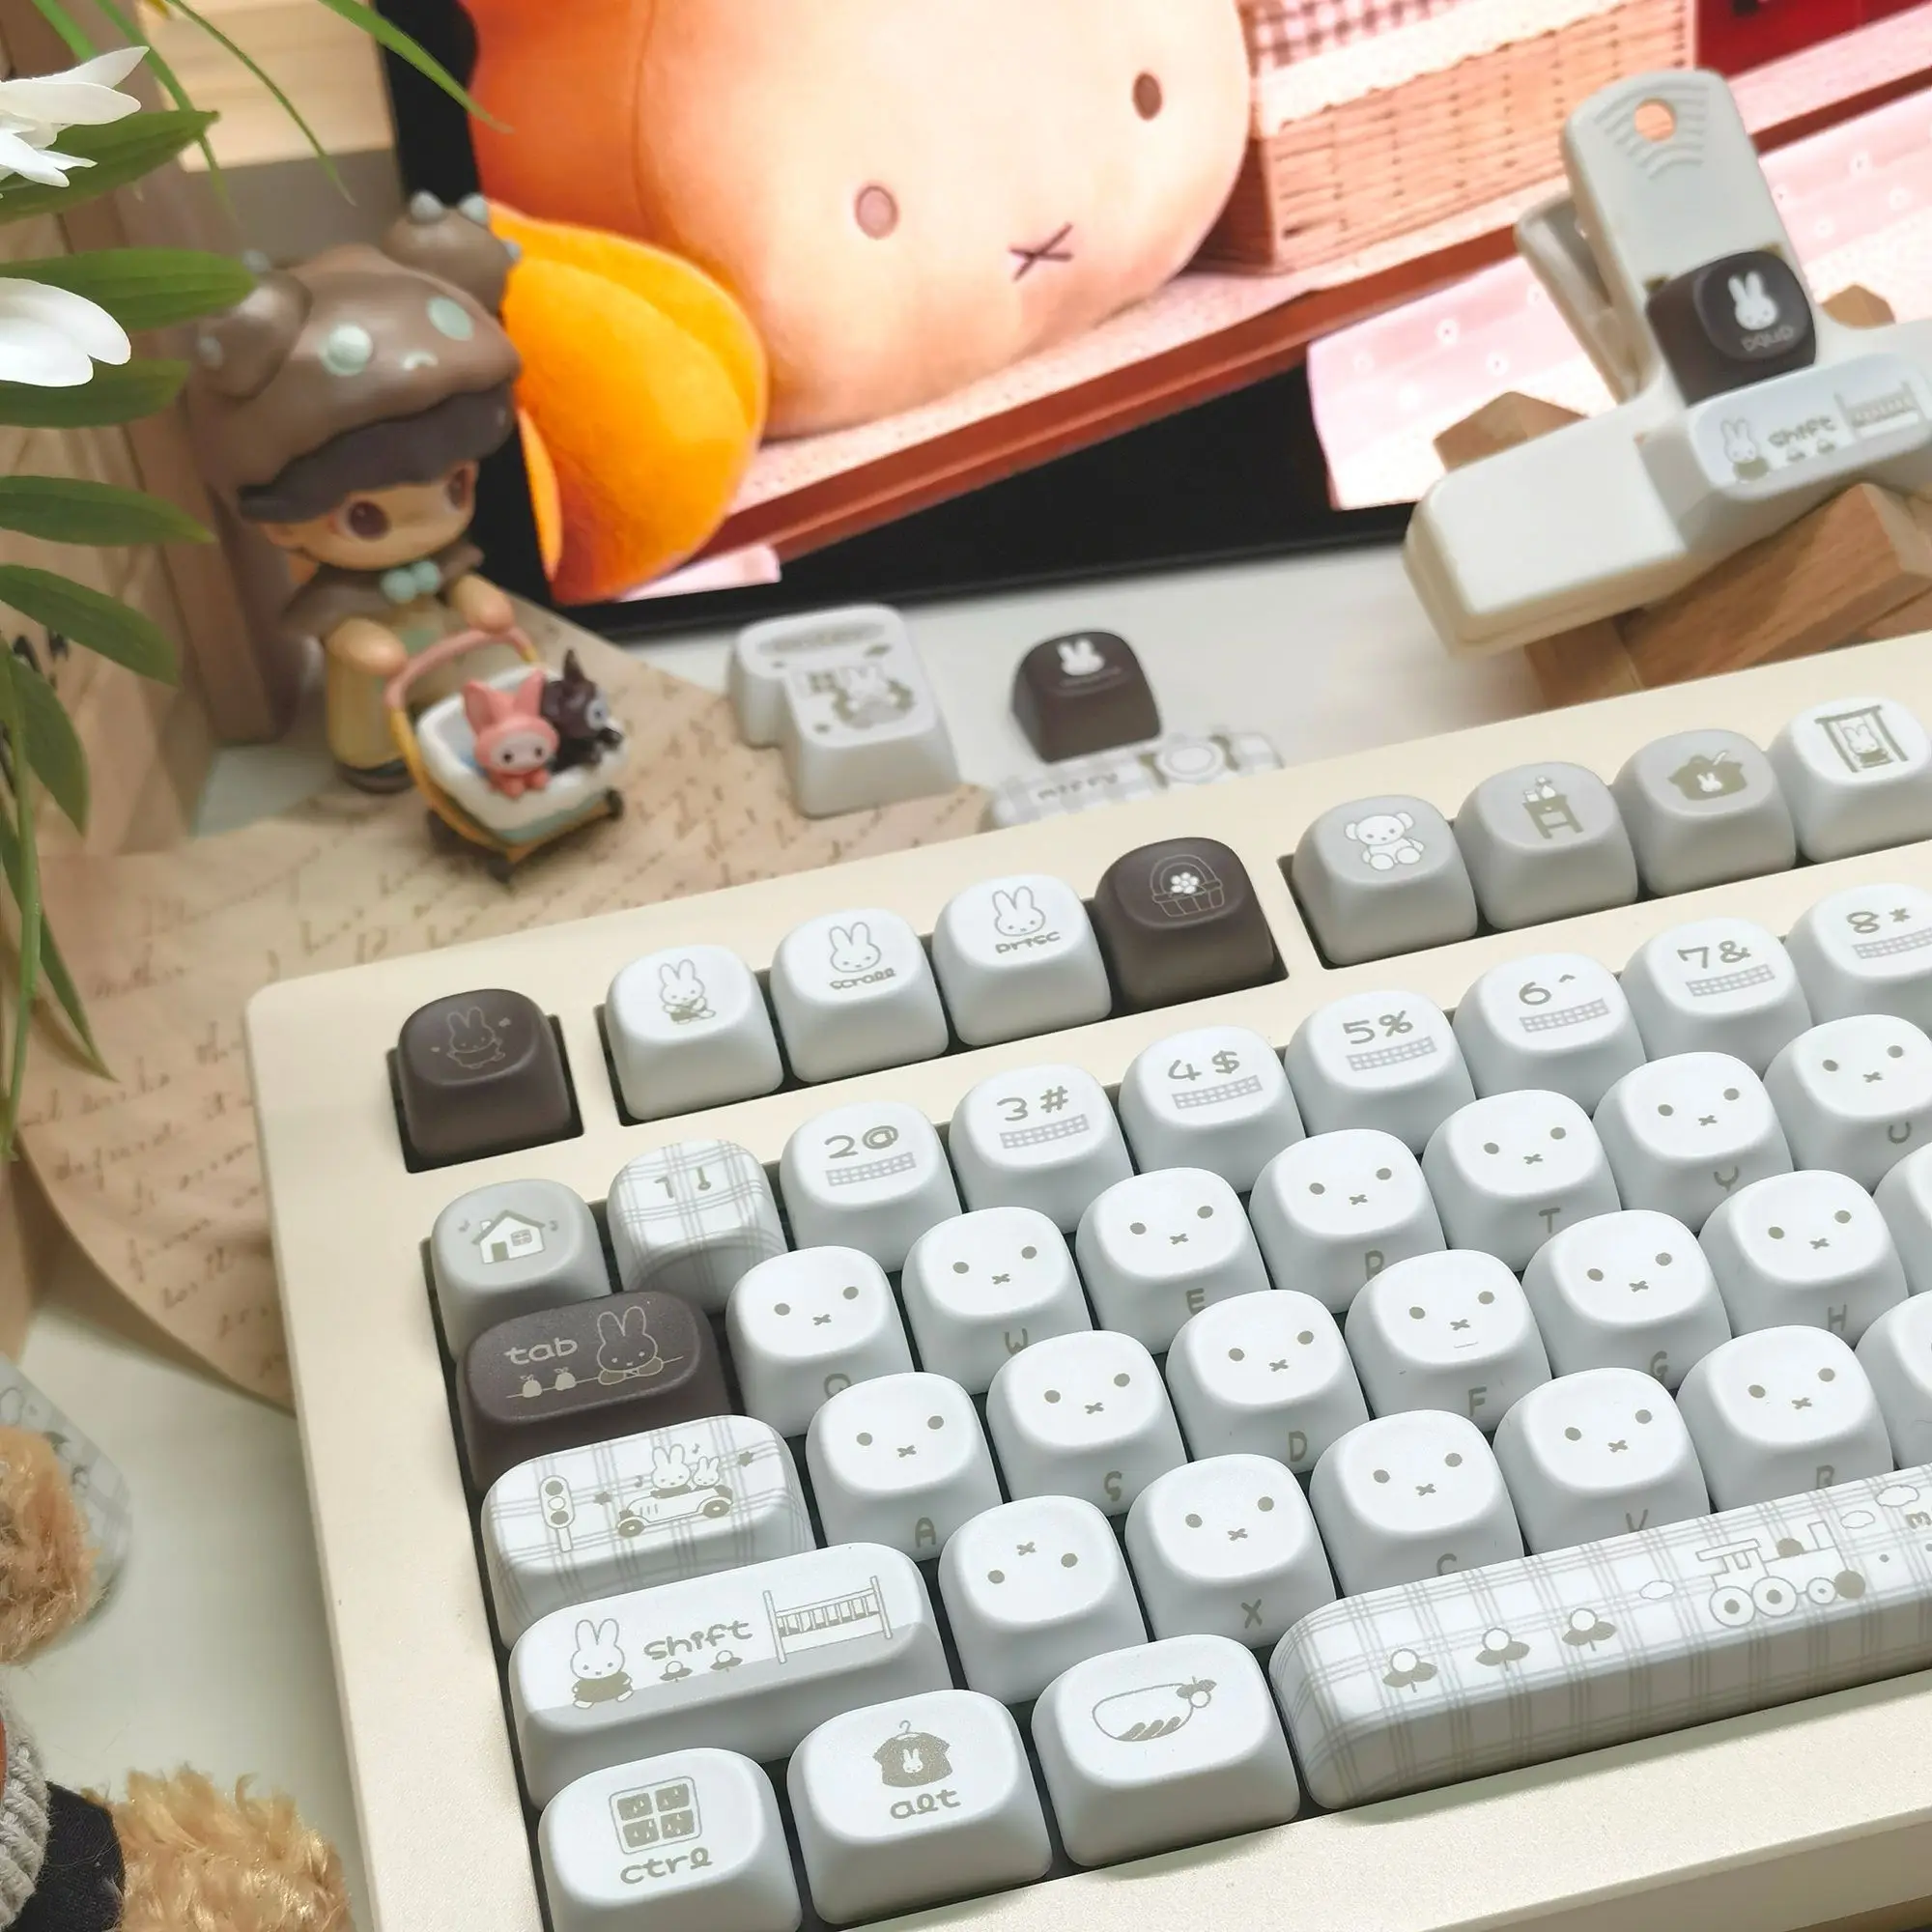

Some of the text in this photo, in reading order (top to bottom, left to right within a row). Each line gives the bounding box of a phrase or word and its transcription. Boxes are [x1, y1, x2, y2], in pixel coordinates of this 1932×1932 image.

[1888, 1121, 1912, 1145] U
[1713, 1165, 1739, 1192] Y
[1539, 1207, 1561, 1234] T
[1186, 1288, 1206, 1316] E
[1827, 1303, 1847, 1332] H
[504, 1337, 579, 1366] tab
[1468, 1385, 1488, 1417] F
[1289, 1430, 1308, 1463] D
[915, 1517, 936, 1548] A
[1240, 1599, 1263, 1630] X
[890, 1789, 962, 1820] alt
[619, 1847, 714, 1885] ctrl
